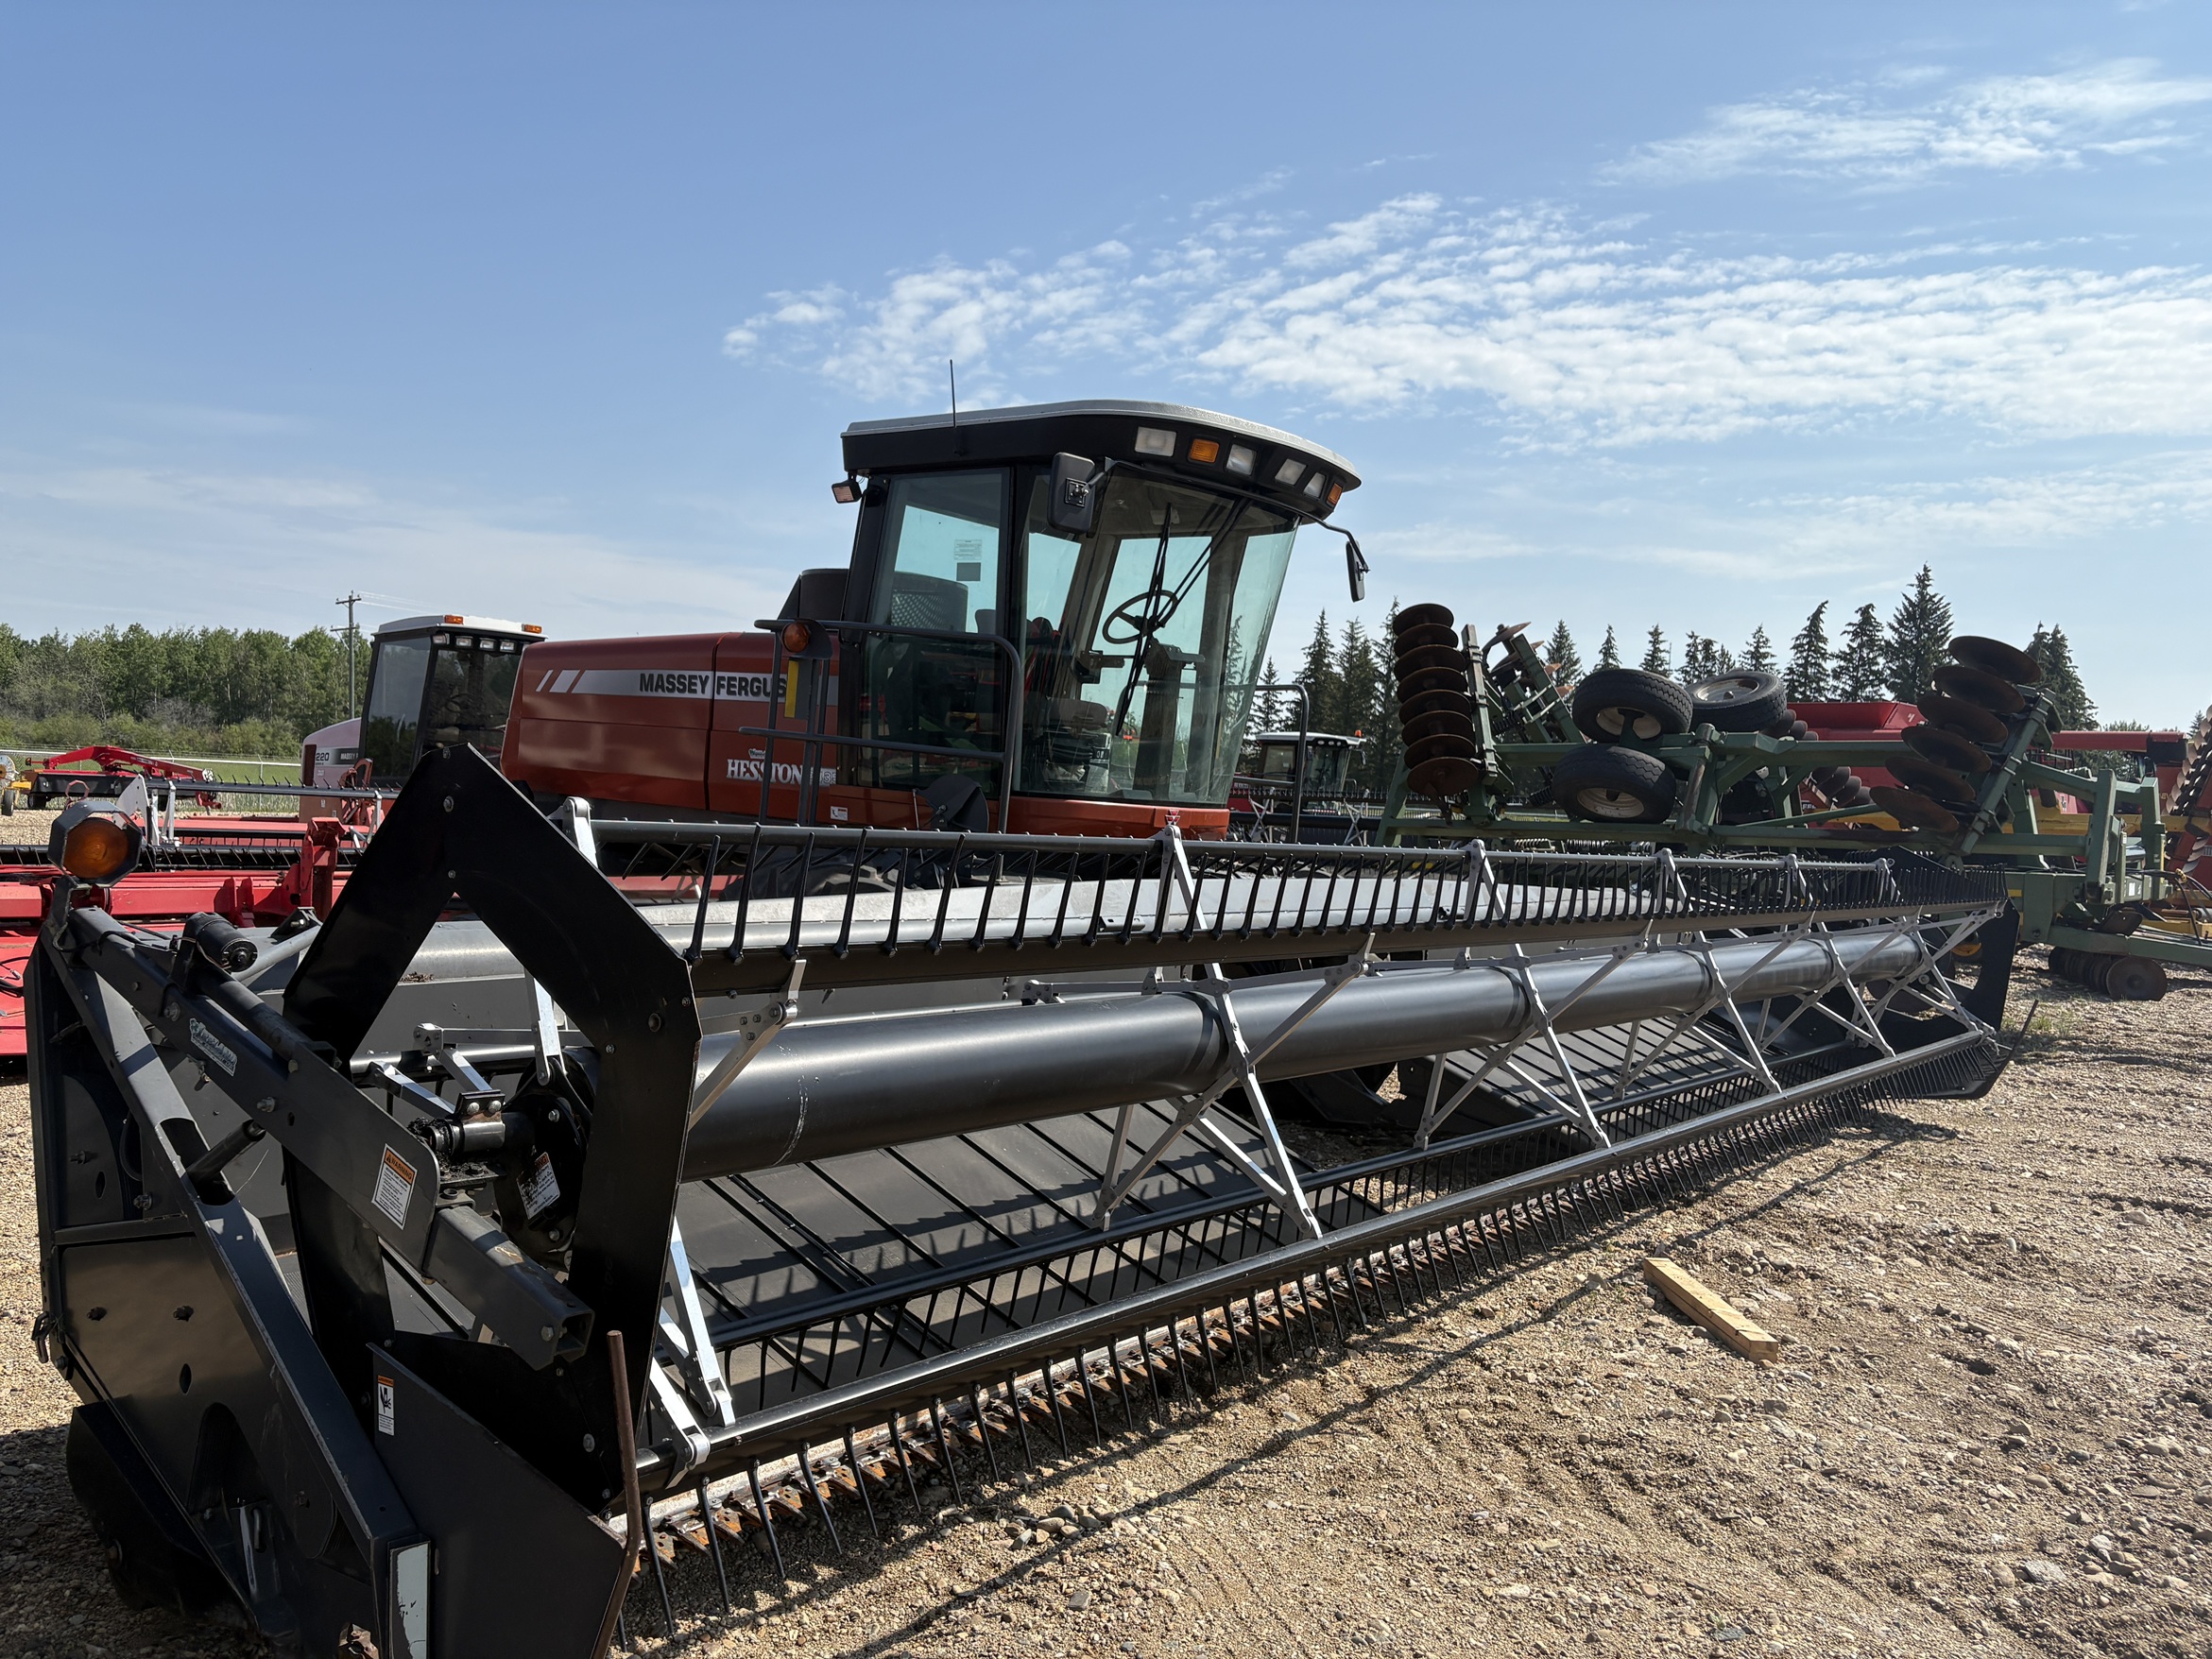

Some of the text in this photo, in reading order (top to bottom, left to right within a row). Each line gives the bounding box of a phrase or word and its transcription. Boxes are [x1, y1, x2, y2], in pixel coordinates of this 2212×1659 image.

[639, 673, 788, 698] MASSEY FERGUS
[316, 752, 330, 761] 220
[390, 1157, 413, 1180] WARNING
